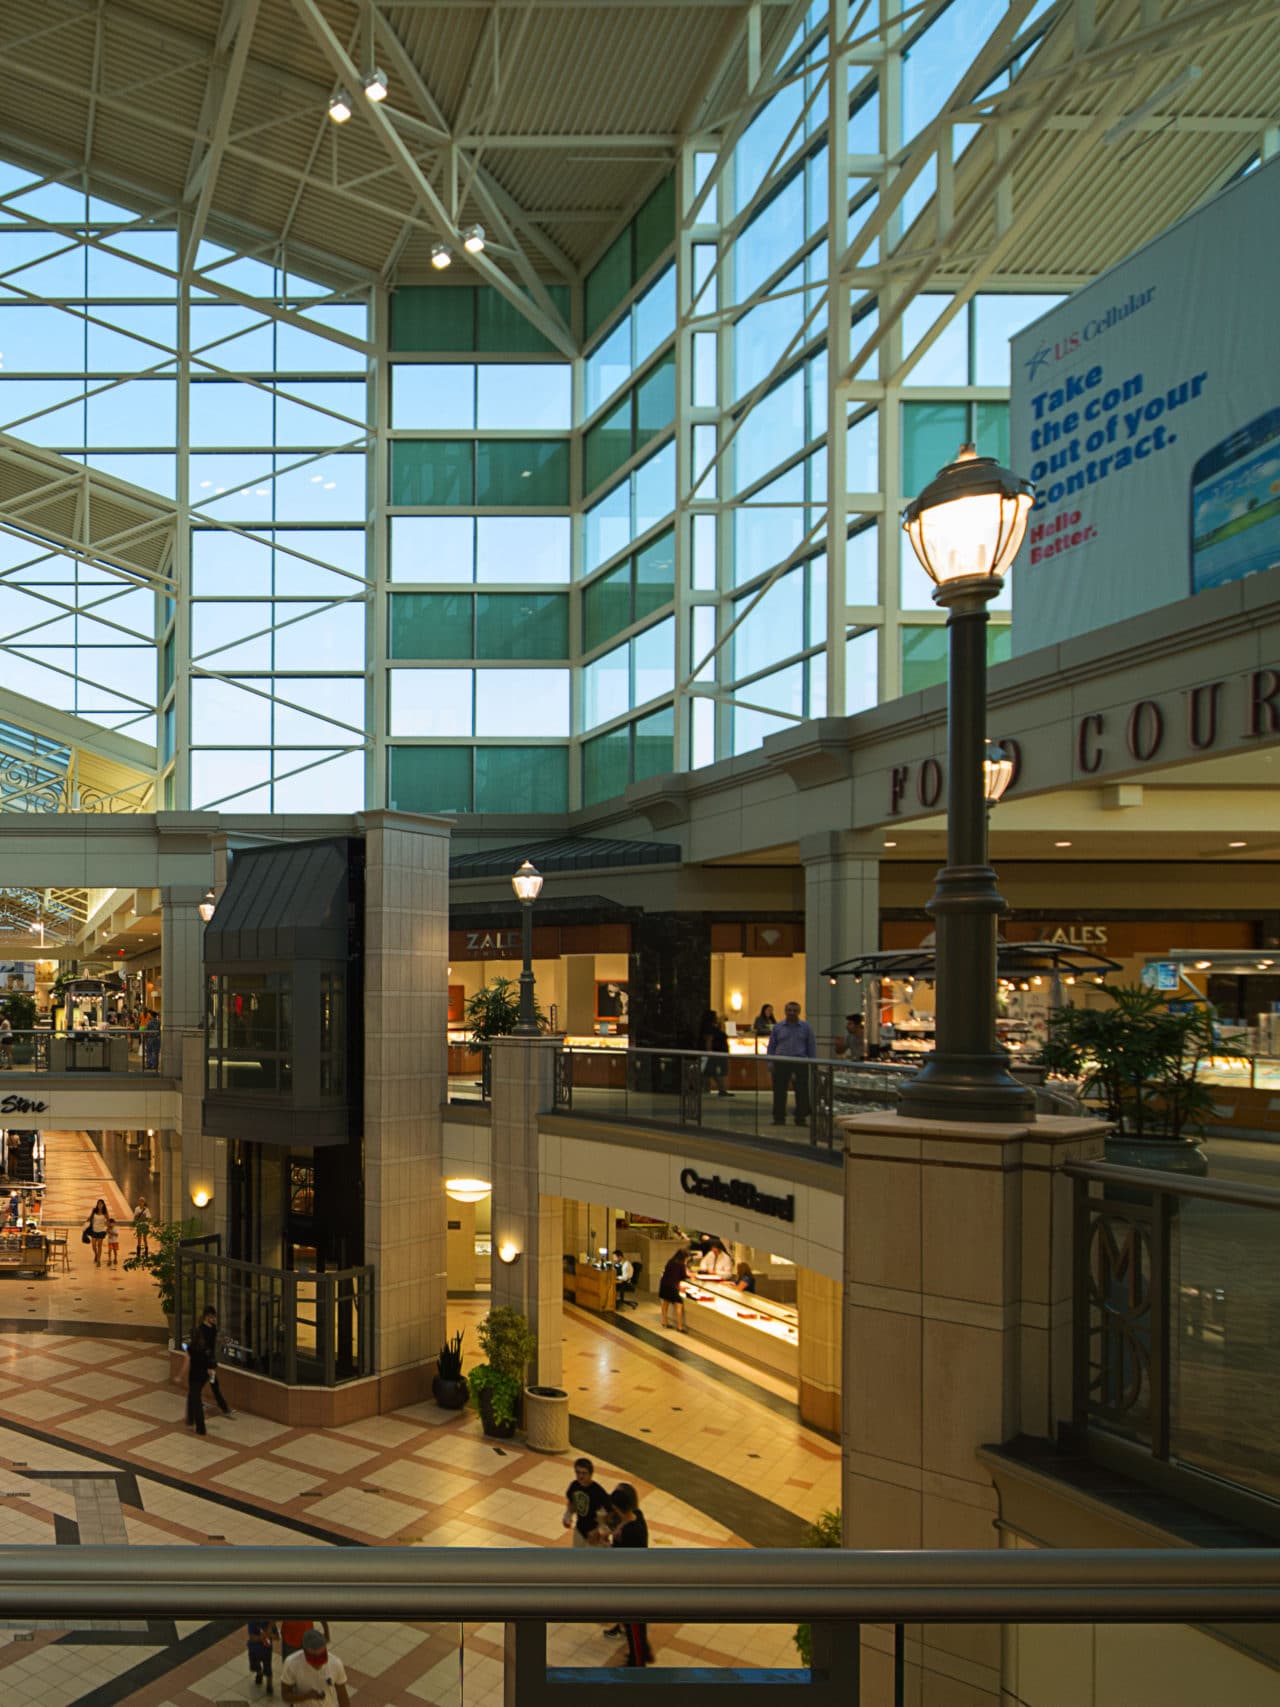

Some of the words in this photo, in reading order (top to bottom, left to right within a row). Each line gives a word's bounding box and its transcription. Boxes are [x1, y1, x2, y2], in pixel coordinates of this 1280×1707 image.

[1082, 285, 1157, 342] Cellular
[1030, 416, 1080, 453] the
[1083, 372, 1143, 421] con
[1031, 364, 1103, 420] Take
[1029, 438, 1080, 482] out
[1085, 414, 1119, 454] of
[1123, 370, 1209, 438] your
[1032, 424, 1178, 512] contract.
[1029, 509, 1083, 546] Hello
[1029, 522, 1099, 566] Better.
[886, 738, 1022, 816] FOD
[465, 932, 522, 951] ZALE
[1040, 925, 1108, 945] ZALES
[0, 1094, 52, 1113] Store
